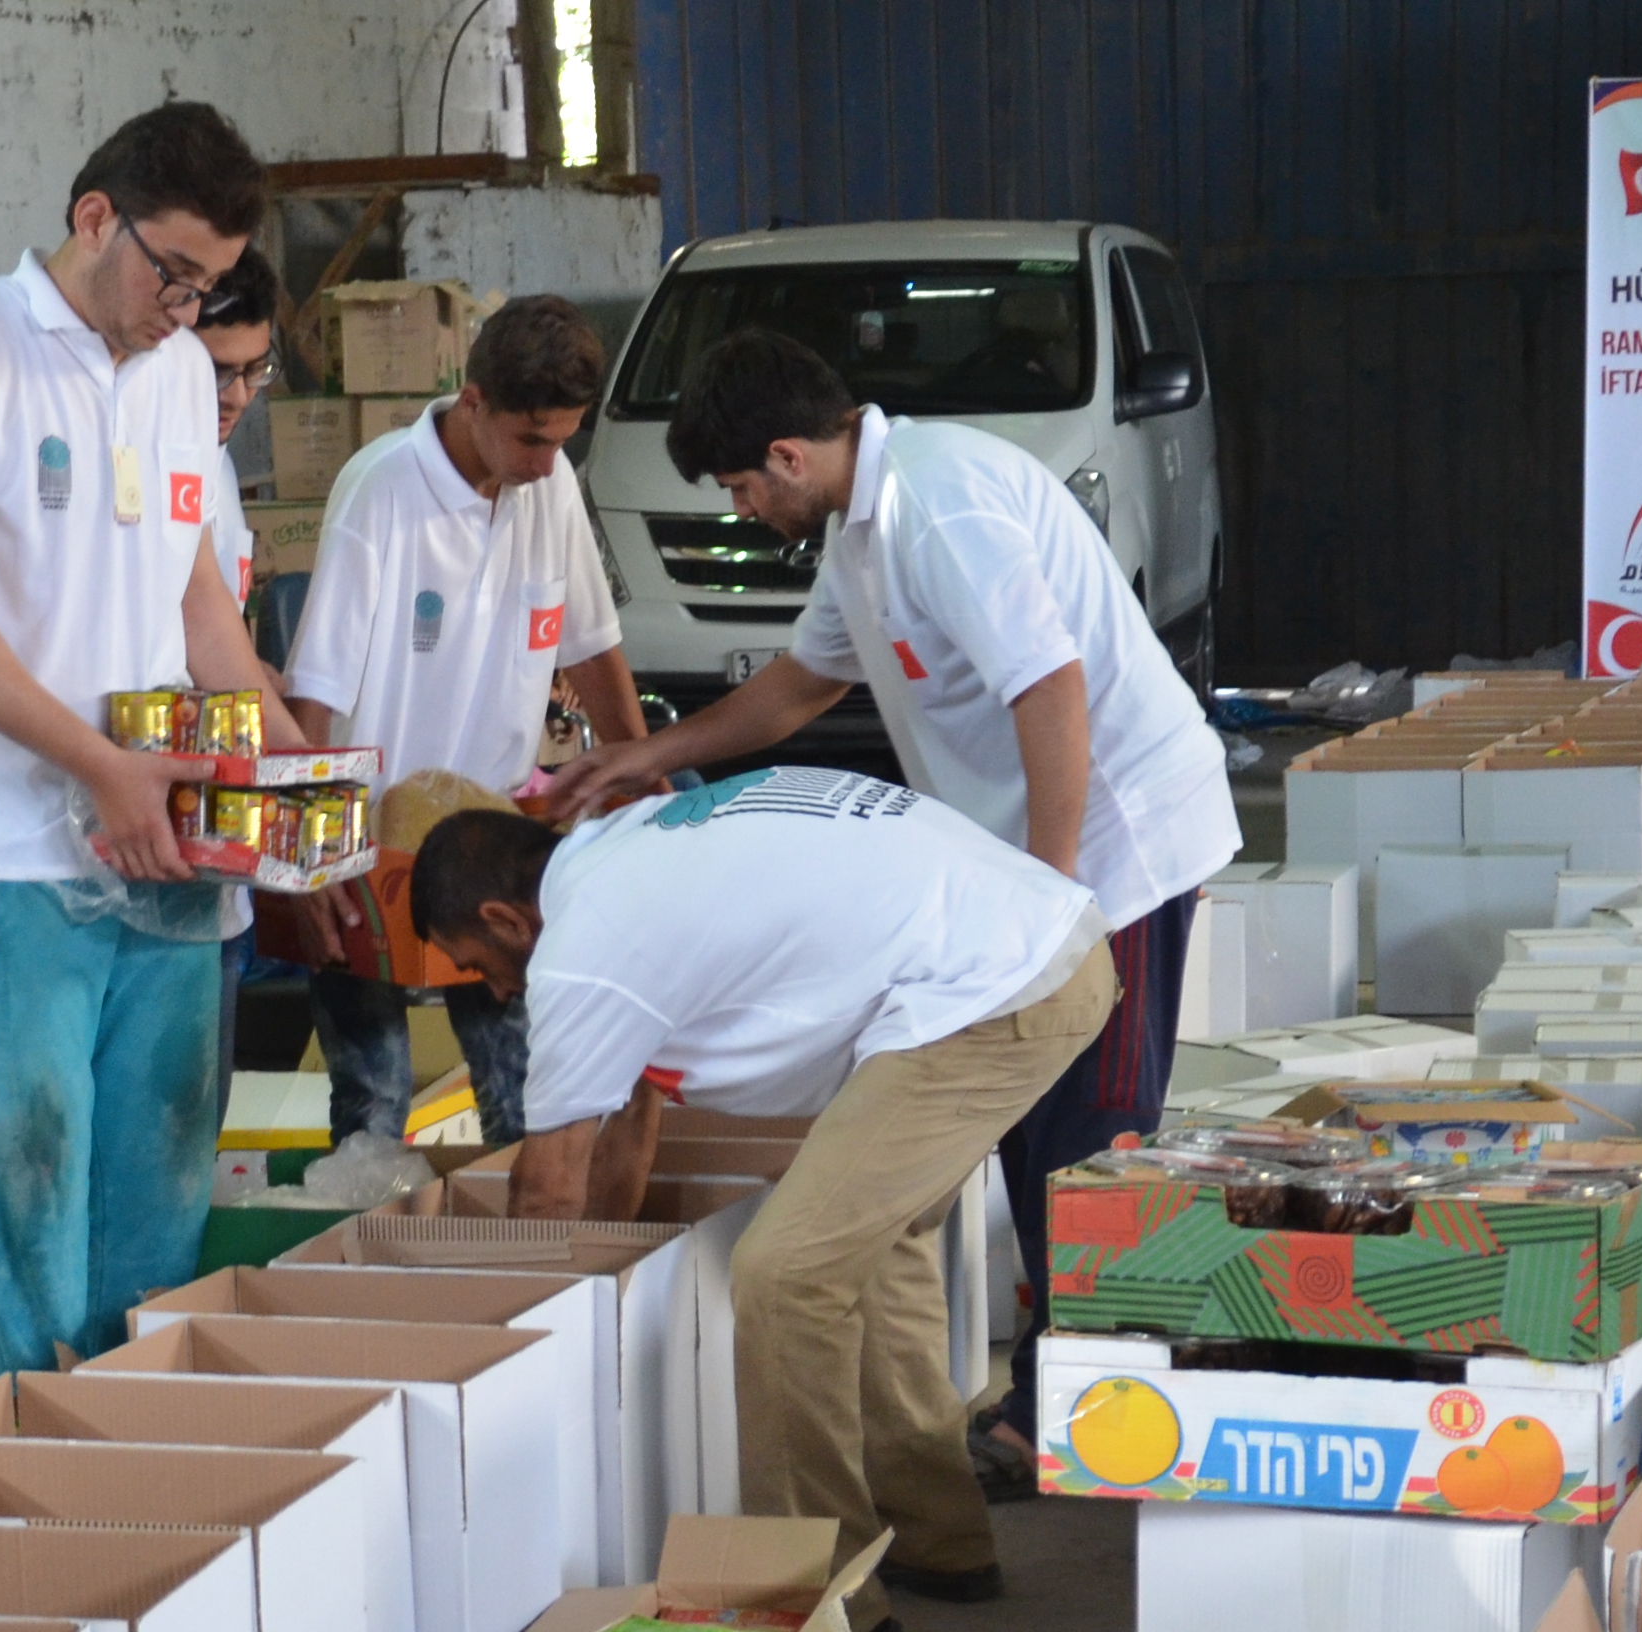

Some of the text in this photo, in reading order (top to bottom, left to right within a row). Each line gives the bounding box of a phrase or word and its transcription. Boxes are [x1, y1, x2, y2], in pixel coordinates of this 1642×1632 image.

[882, 786, 918, 816] VAKF
[1222, 1428, 1386, 1501] פרי הדר
